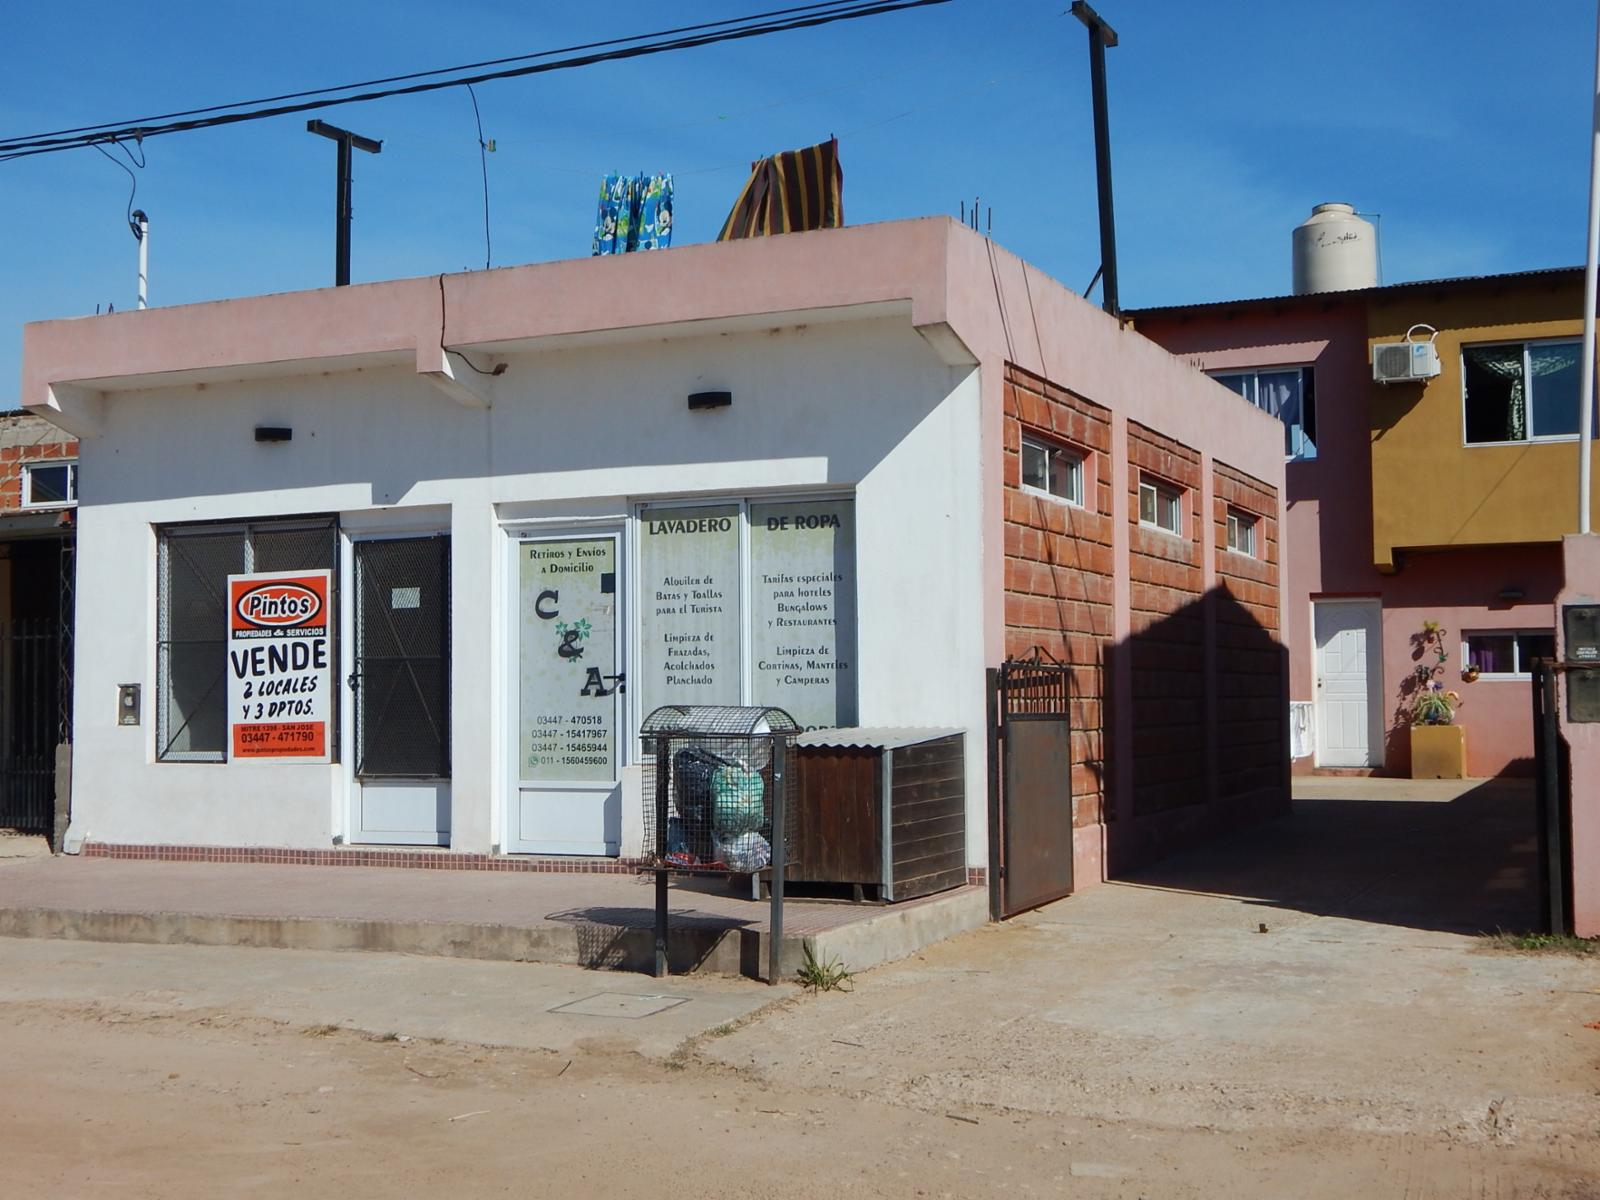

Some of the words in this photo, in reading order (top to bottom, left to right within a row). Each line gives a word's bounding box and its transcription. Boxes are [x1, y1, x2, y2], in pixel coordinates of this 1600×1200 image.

[649, 517, 731, 535] LAVADERO
[767, 516, 788, 531] DE
[795, 514, 841, 529] ROPA
[530, 548, 564, 559] Retiros
[568, 551, 573, 559] y
[550, 562, 594, 573] Domicilio
[704, 575, 713, 584] de
[762, 574, 793, 583] Tarifas
[797, 572, 842, 584] especiales
[656, 591, 680, 600] Batas
[684, 593, 688, 602] y
[691, 589, 722, 599] Toallas
[773, 591, 794, 600] para
[798, 587, 832, 597] hoteles
[249, 594, 311, 616] Pintos
[656, 607, 676, 616] para
[679, 604, 687, 613] el
[690, 604, 722, 613] Turista
[778, 602, 828, 613] Bungalows
[768, 620, 773, 629] y
[776, 618, 838, 627] Restaurantes
[235, 629, 272, 638] PROPIEDADES
[273, 629, 285, 637] &
[286, 627, 324, 636] SERVICIOS
[664, 633, 701, 644] Limpieza
[704, 632, 714, 642] de
[535, 590, 559, 619] C
[558, 630, 584, 658] &
[581, 667, 607, 697] A
[668, 647, 710, 657] Frazadas,
[776, 646, 815, 656] Limpieza
[818, 646, 829, 655] de
[231, 639, 327, 679] VENDE
[664, 661, 715, 671] Acolchados
[758, 660, 802, 671] Cortinas,
[806, 660, 848, 670] Manteles
[667, 675, 713, 685] Planchado
[776, 677, 780, 686] y
[784, 675, 830, 686] Camperas
[243, 682, 253, 699] 2
[258, 675, 318, 697] LOCALES
[243, 705, 250, 719] Y
[254, 703, 264, 719] 3
[268, 698, 314, 718] DPTOS.
[537, 716, 562, 725] 03447
[571, 716, 602, 725] 470518
[241, 732, 270, 743] 03447
[277, 731, 314, 742] 471790
[531, 729, 557, 738] 03447
[566, 729, 607, 738] 15417967
[531, 743, 557, 752] 03447
[566, 743, 607, 752] 15465944
[541, 756, 553, 765] 011
